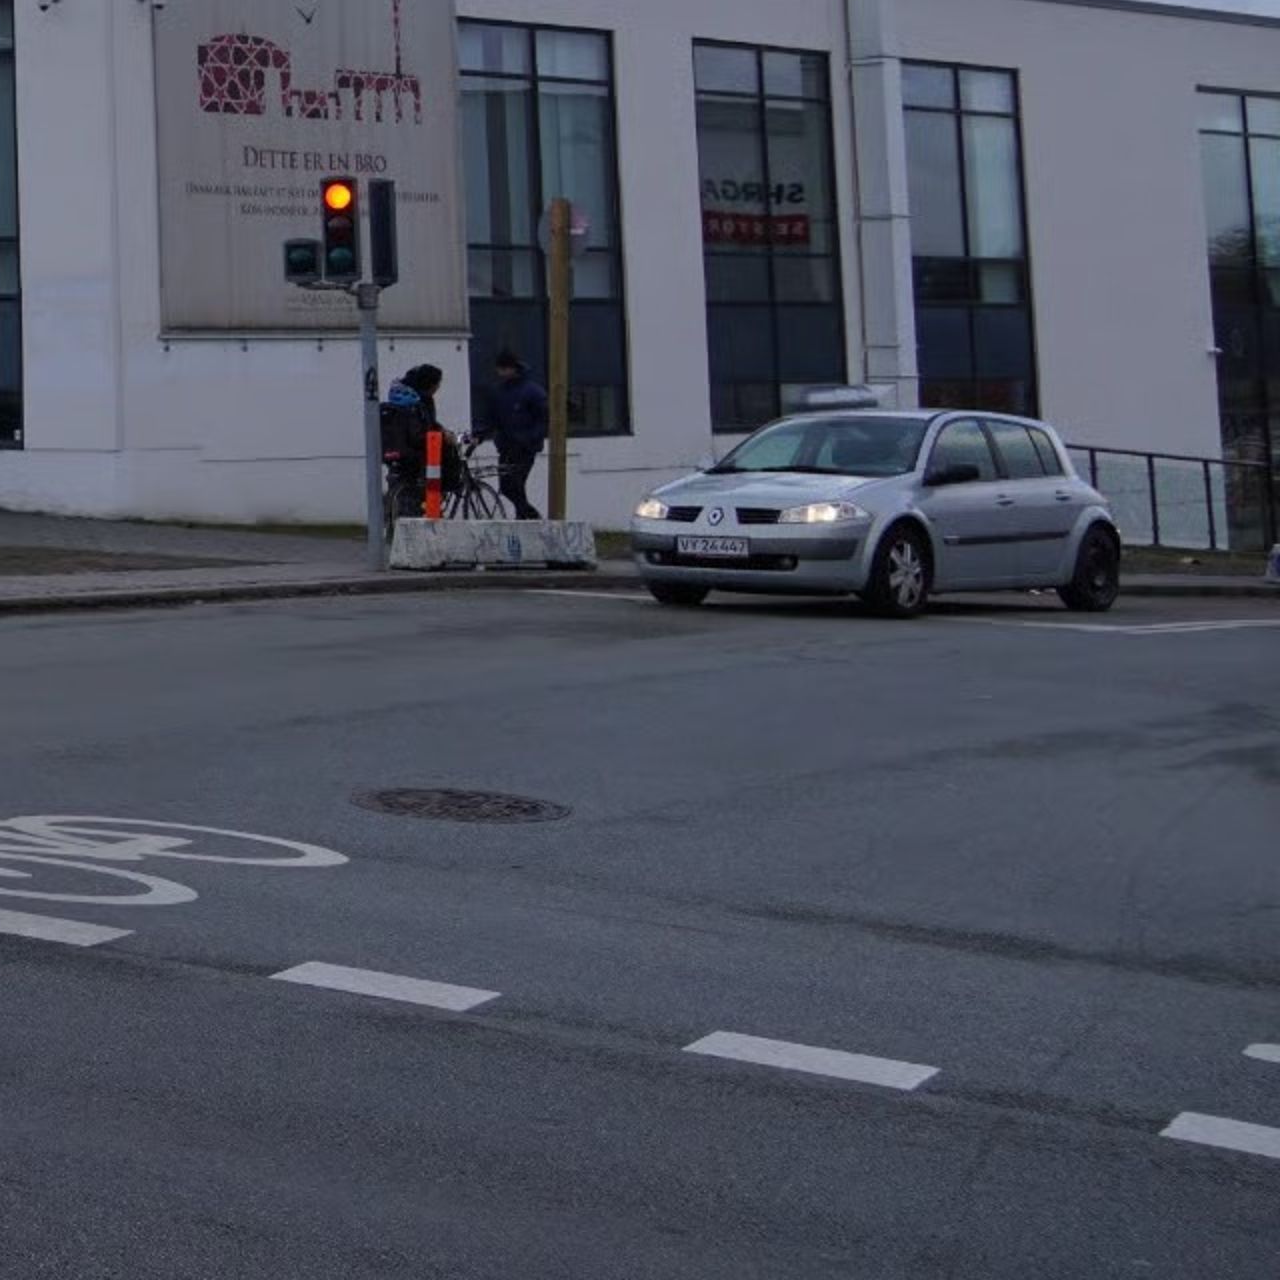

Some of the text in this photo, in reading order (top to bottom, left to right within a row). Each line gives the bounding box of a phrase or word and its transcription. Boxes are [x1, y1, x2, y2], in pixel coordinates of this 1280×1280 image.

[243, 146, 387, 173] DETTE ER EN BRO
